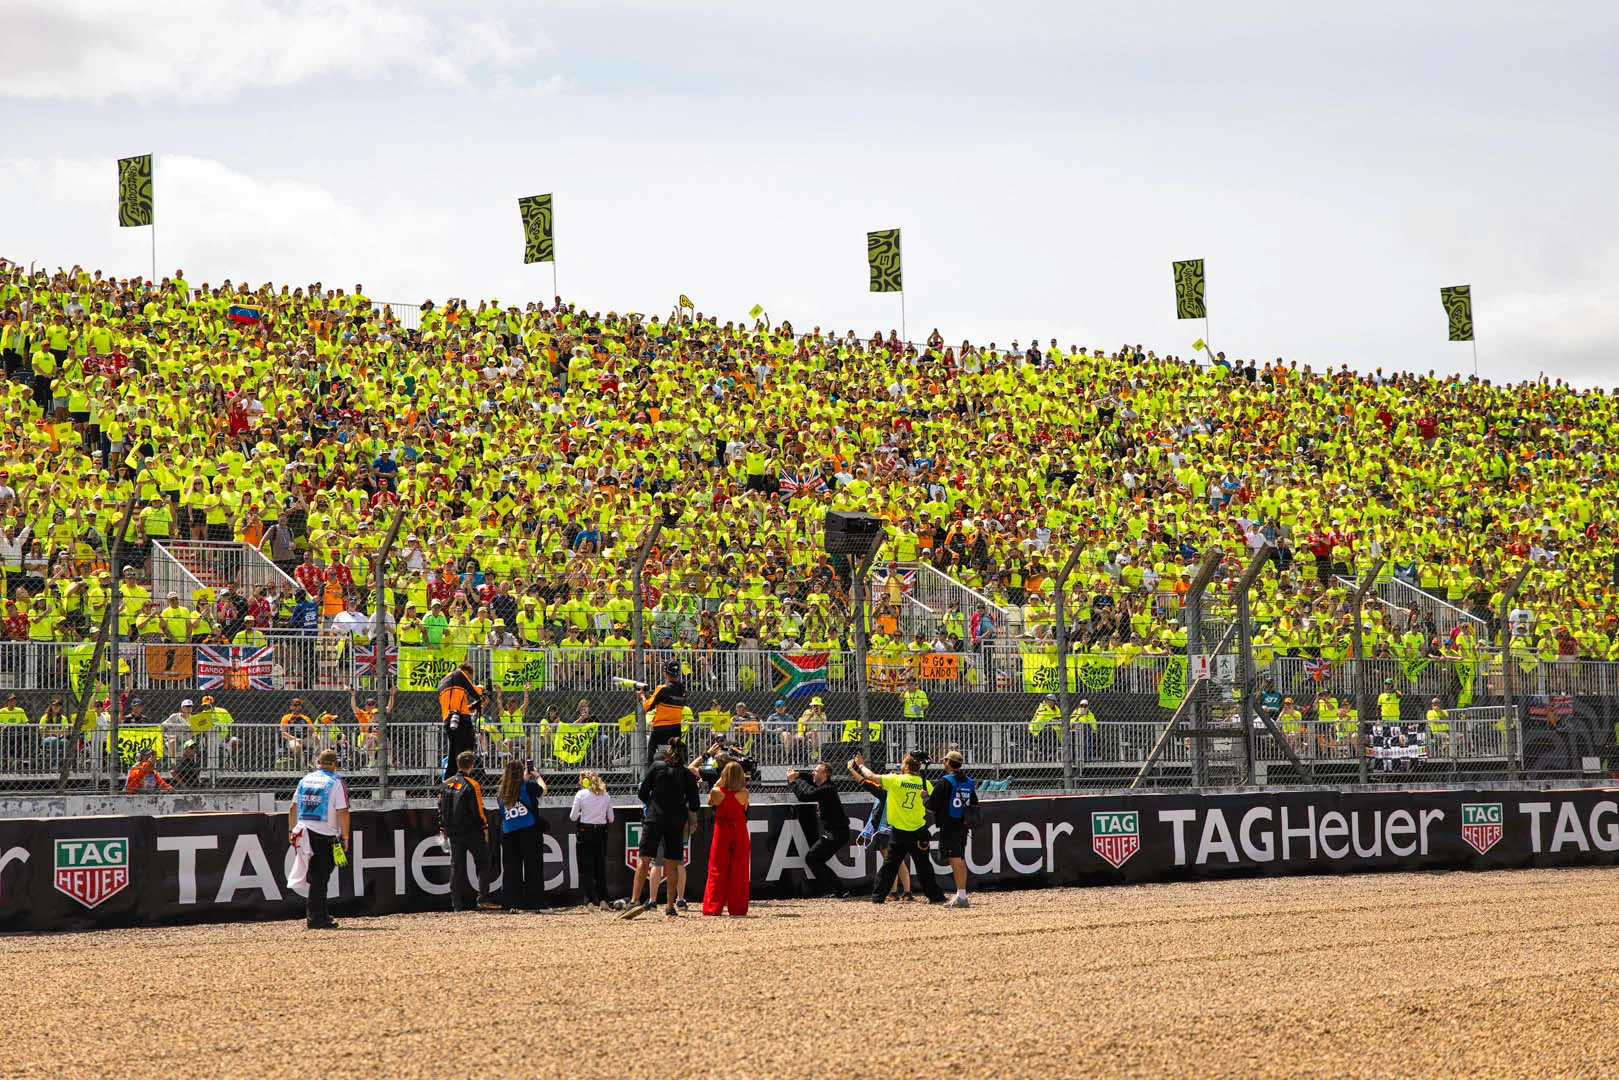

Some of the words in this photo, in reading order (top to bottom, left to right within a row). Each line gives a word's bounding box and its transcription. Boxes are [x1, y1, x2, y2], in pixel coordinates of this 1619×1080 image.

[200, 666, 224, 674] LANDO
[932, 656, 944, 667] GO
[410, 671, 447, 688] STAN
[923, 667, 951, 678] LANDO
[901, 782, 923, 790] NORRIS
[902, 792, 916, 809] 1
[505, 806, 528, 820] 209
[1465, 806, 1500, 823] TAG
[1095, 814, 1135, 833] TAG
[1464, 826, 1501, 850] HEUER
[60, 842, 123, 866] TAG
[1095, 836, 1137, 865] HEUER
[58, 868, 125, 903] HEUER
